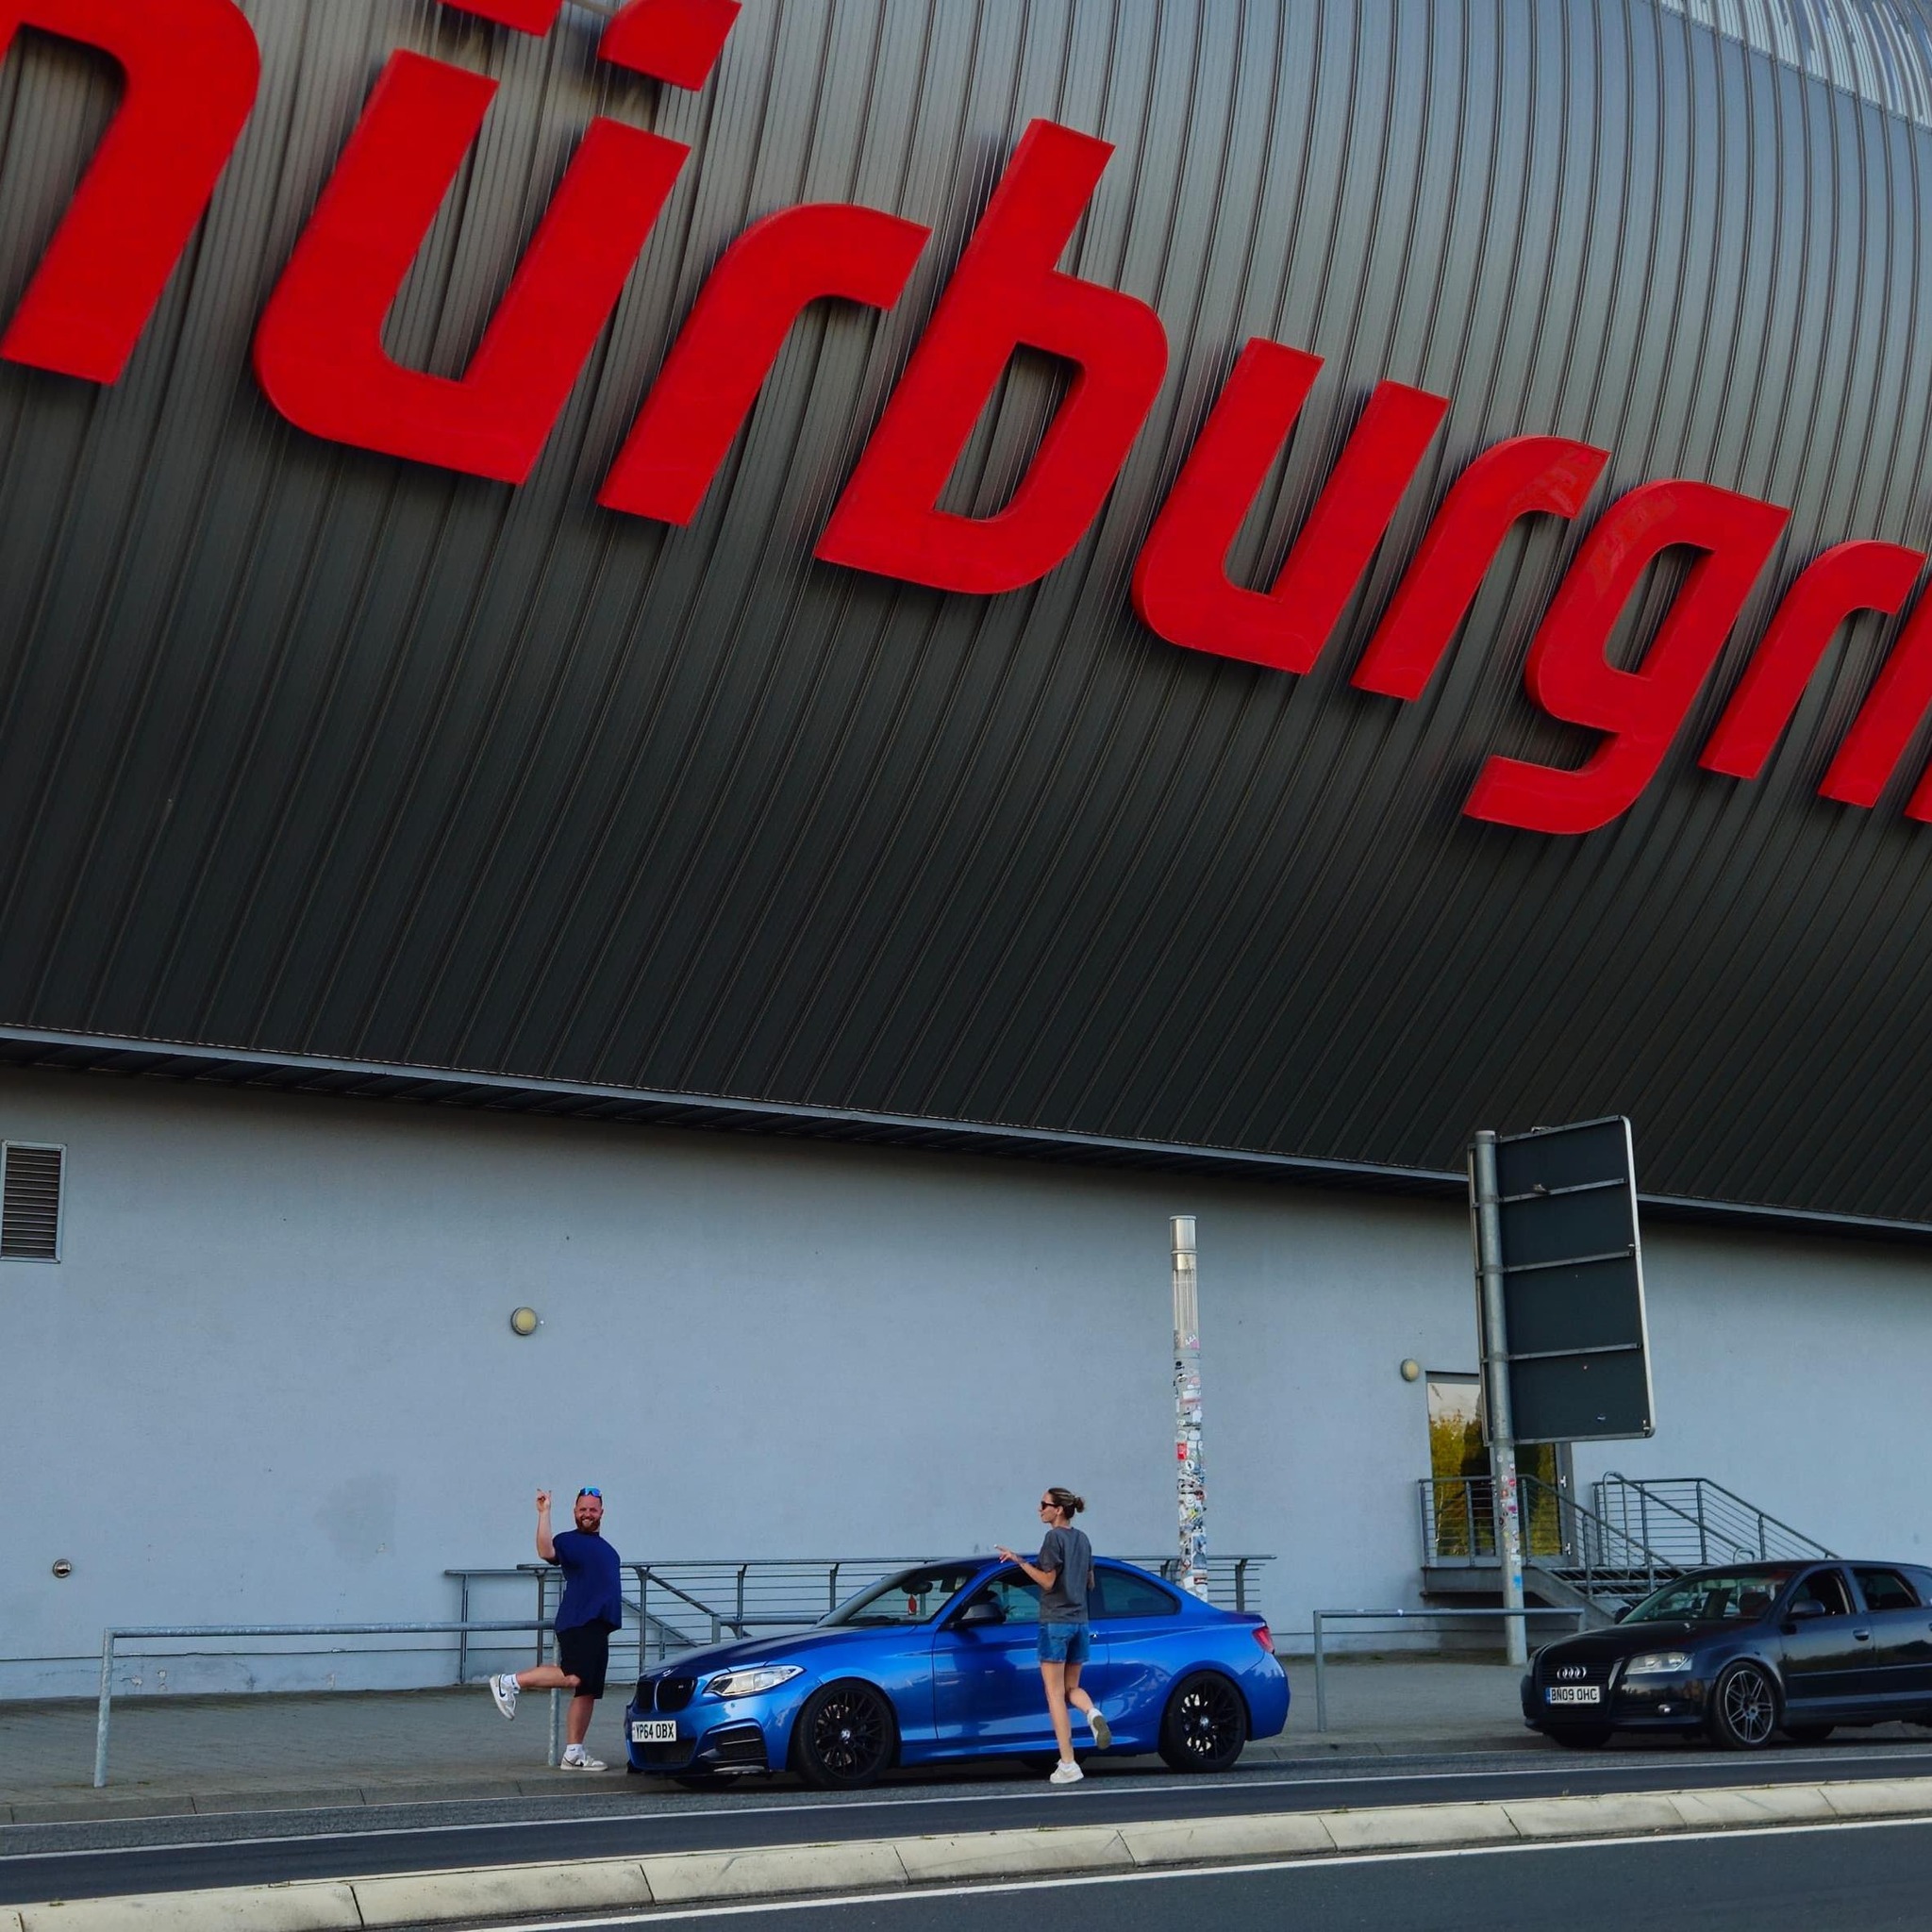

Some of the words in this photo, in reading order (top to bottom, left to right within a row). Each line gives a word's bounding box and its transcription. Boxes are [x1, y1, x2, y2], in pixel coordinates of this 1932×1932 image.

[1551, 1688, 1574, 1701] BN09
[635, 1724, 654, 1740] YP64
[656, 1723, 675, 1739] OBX
